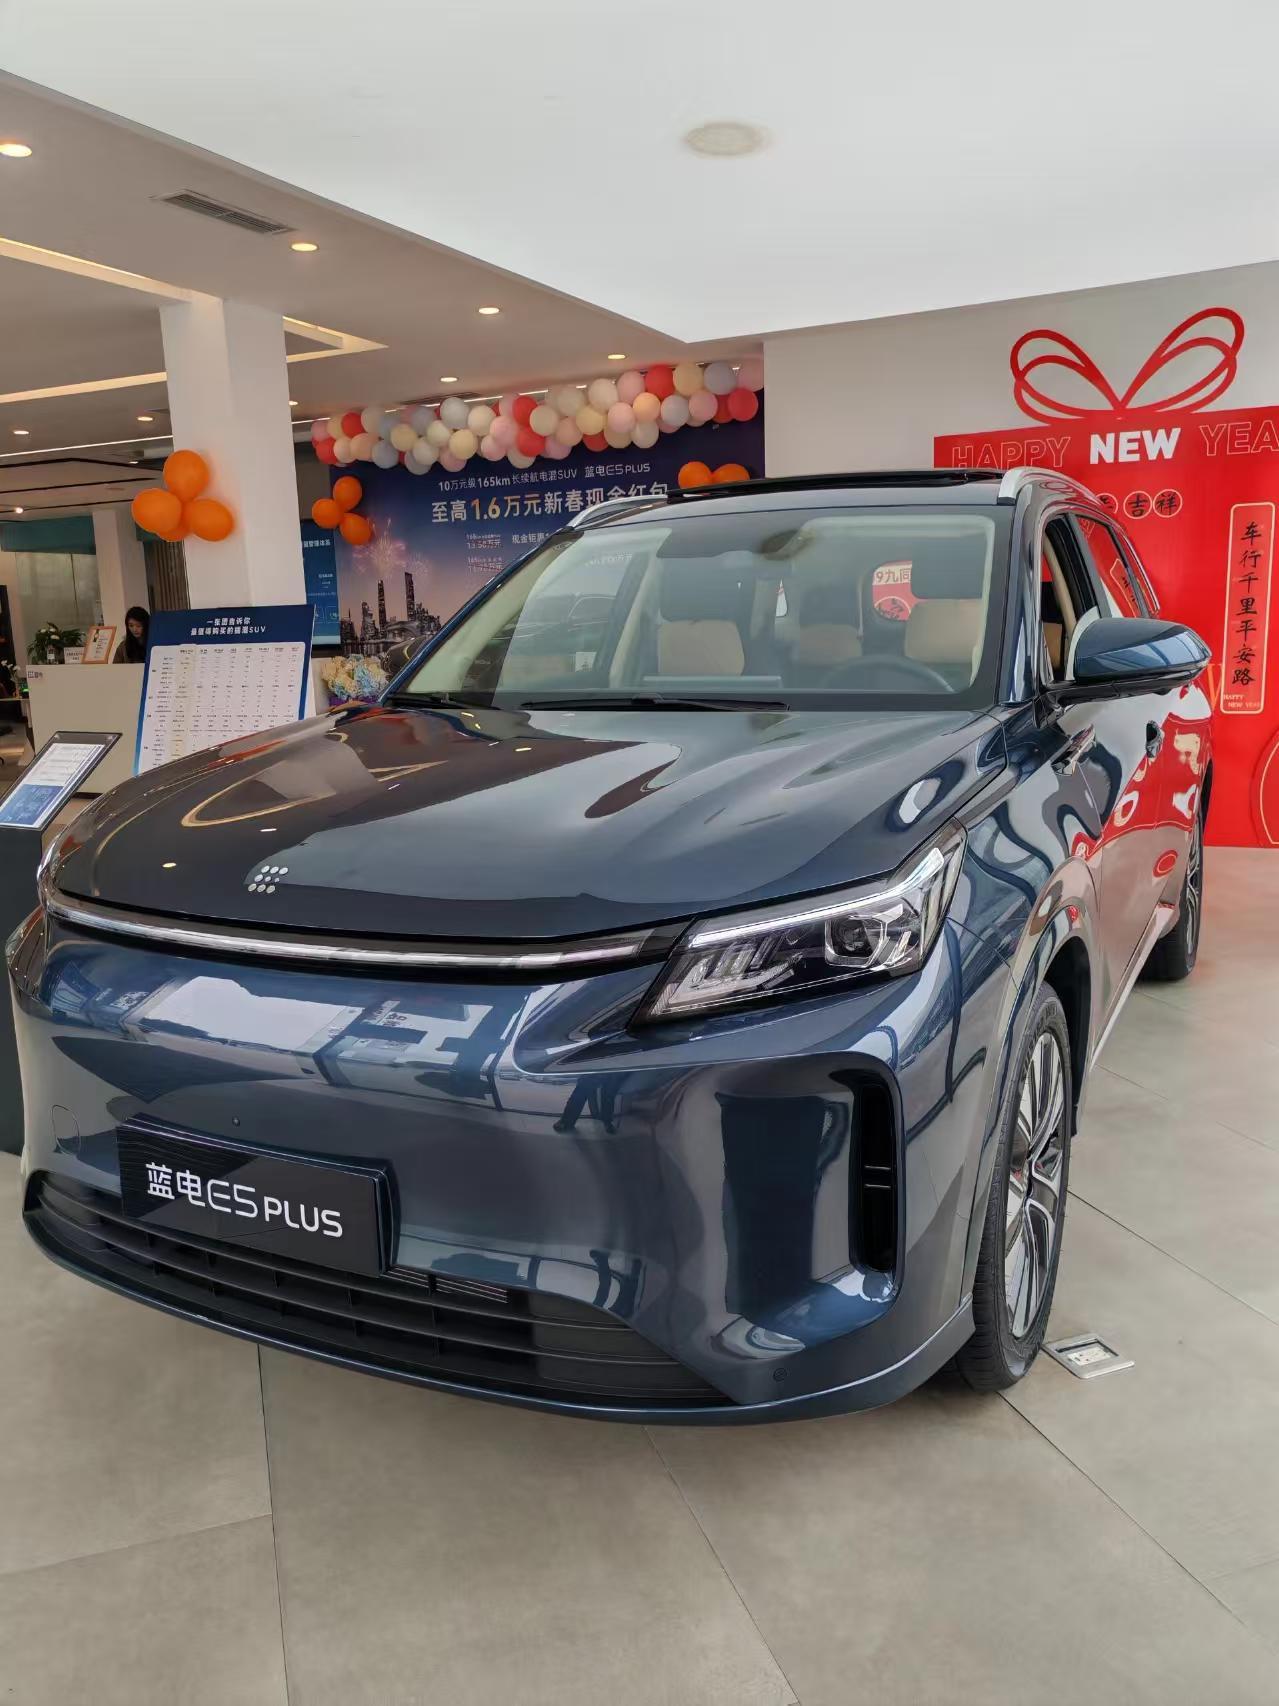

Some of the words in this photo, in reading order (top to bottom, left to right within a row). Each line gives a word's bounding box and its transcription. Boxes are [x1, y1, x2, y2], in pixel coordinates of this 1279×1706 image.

[951, 436, 1071, 470] HAPPY
[1089, 428, 1181, 464] NEW
[1100, 491, 1177, 517] 吉祥
[1231, 521, 1262, 686] 车行千里平安路
[263, 1196, 343, 1238] PLUS
